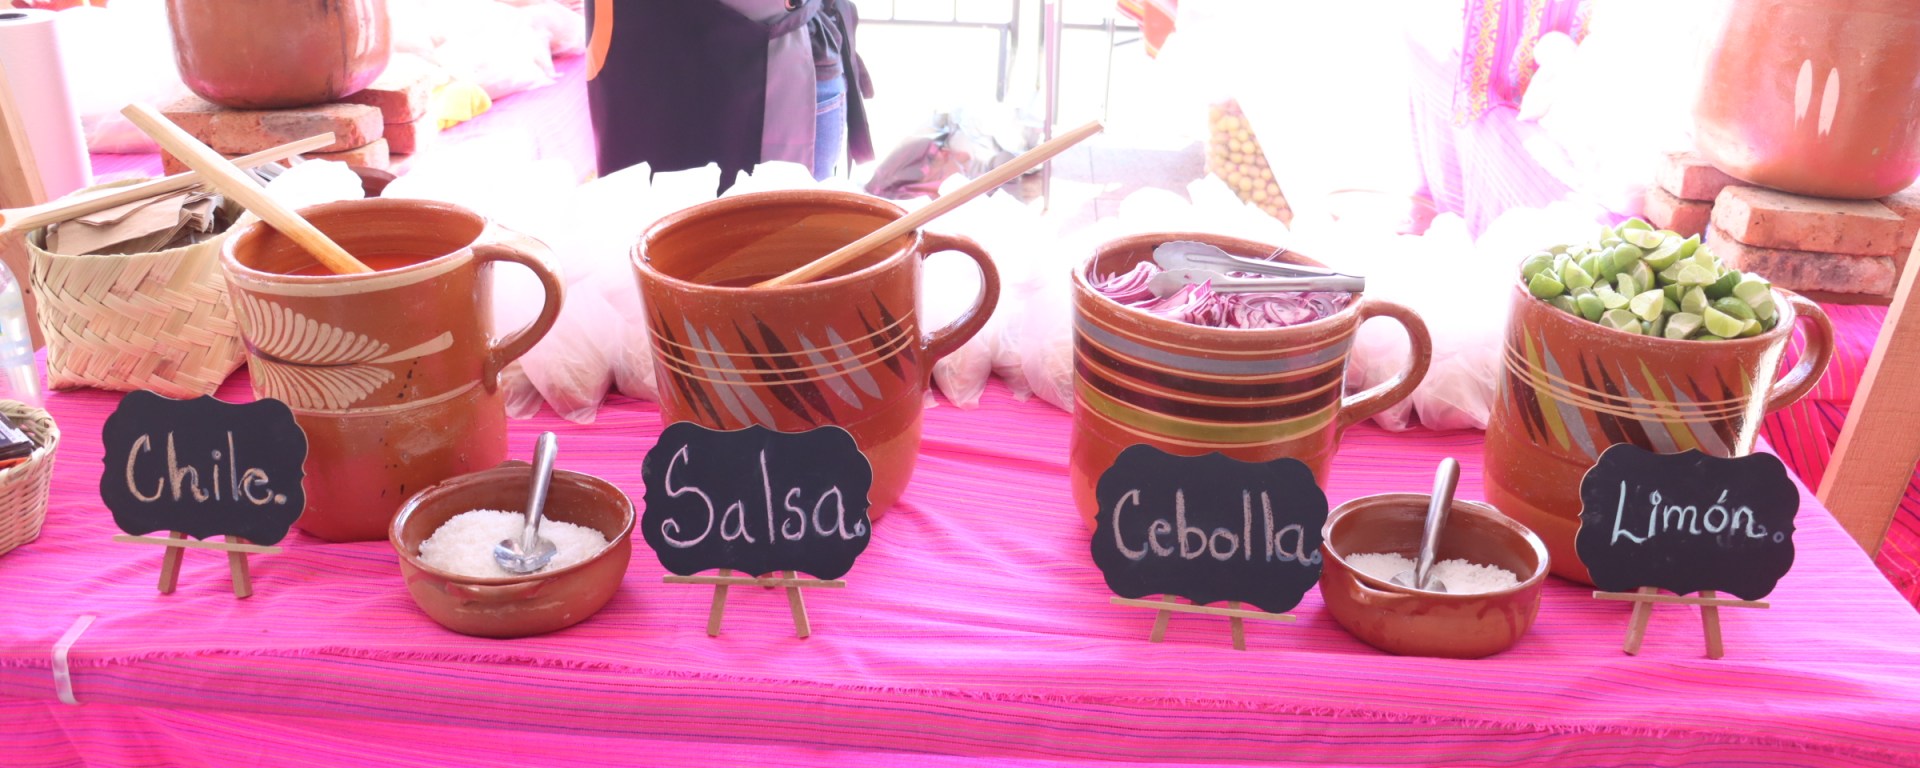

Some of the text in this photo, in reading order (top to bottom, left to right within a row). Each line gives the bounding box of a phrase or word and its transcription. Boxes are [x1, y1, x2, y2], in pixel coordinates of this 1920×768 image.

[126, 430, 287, 505] Chile.
[661, 443, 866, 548] Salsa.
[1112, 488, 1322, 566] Cebolla.
[1610, 480, 1785, 546] Limón.
